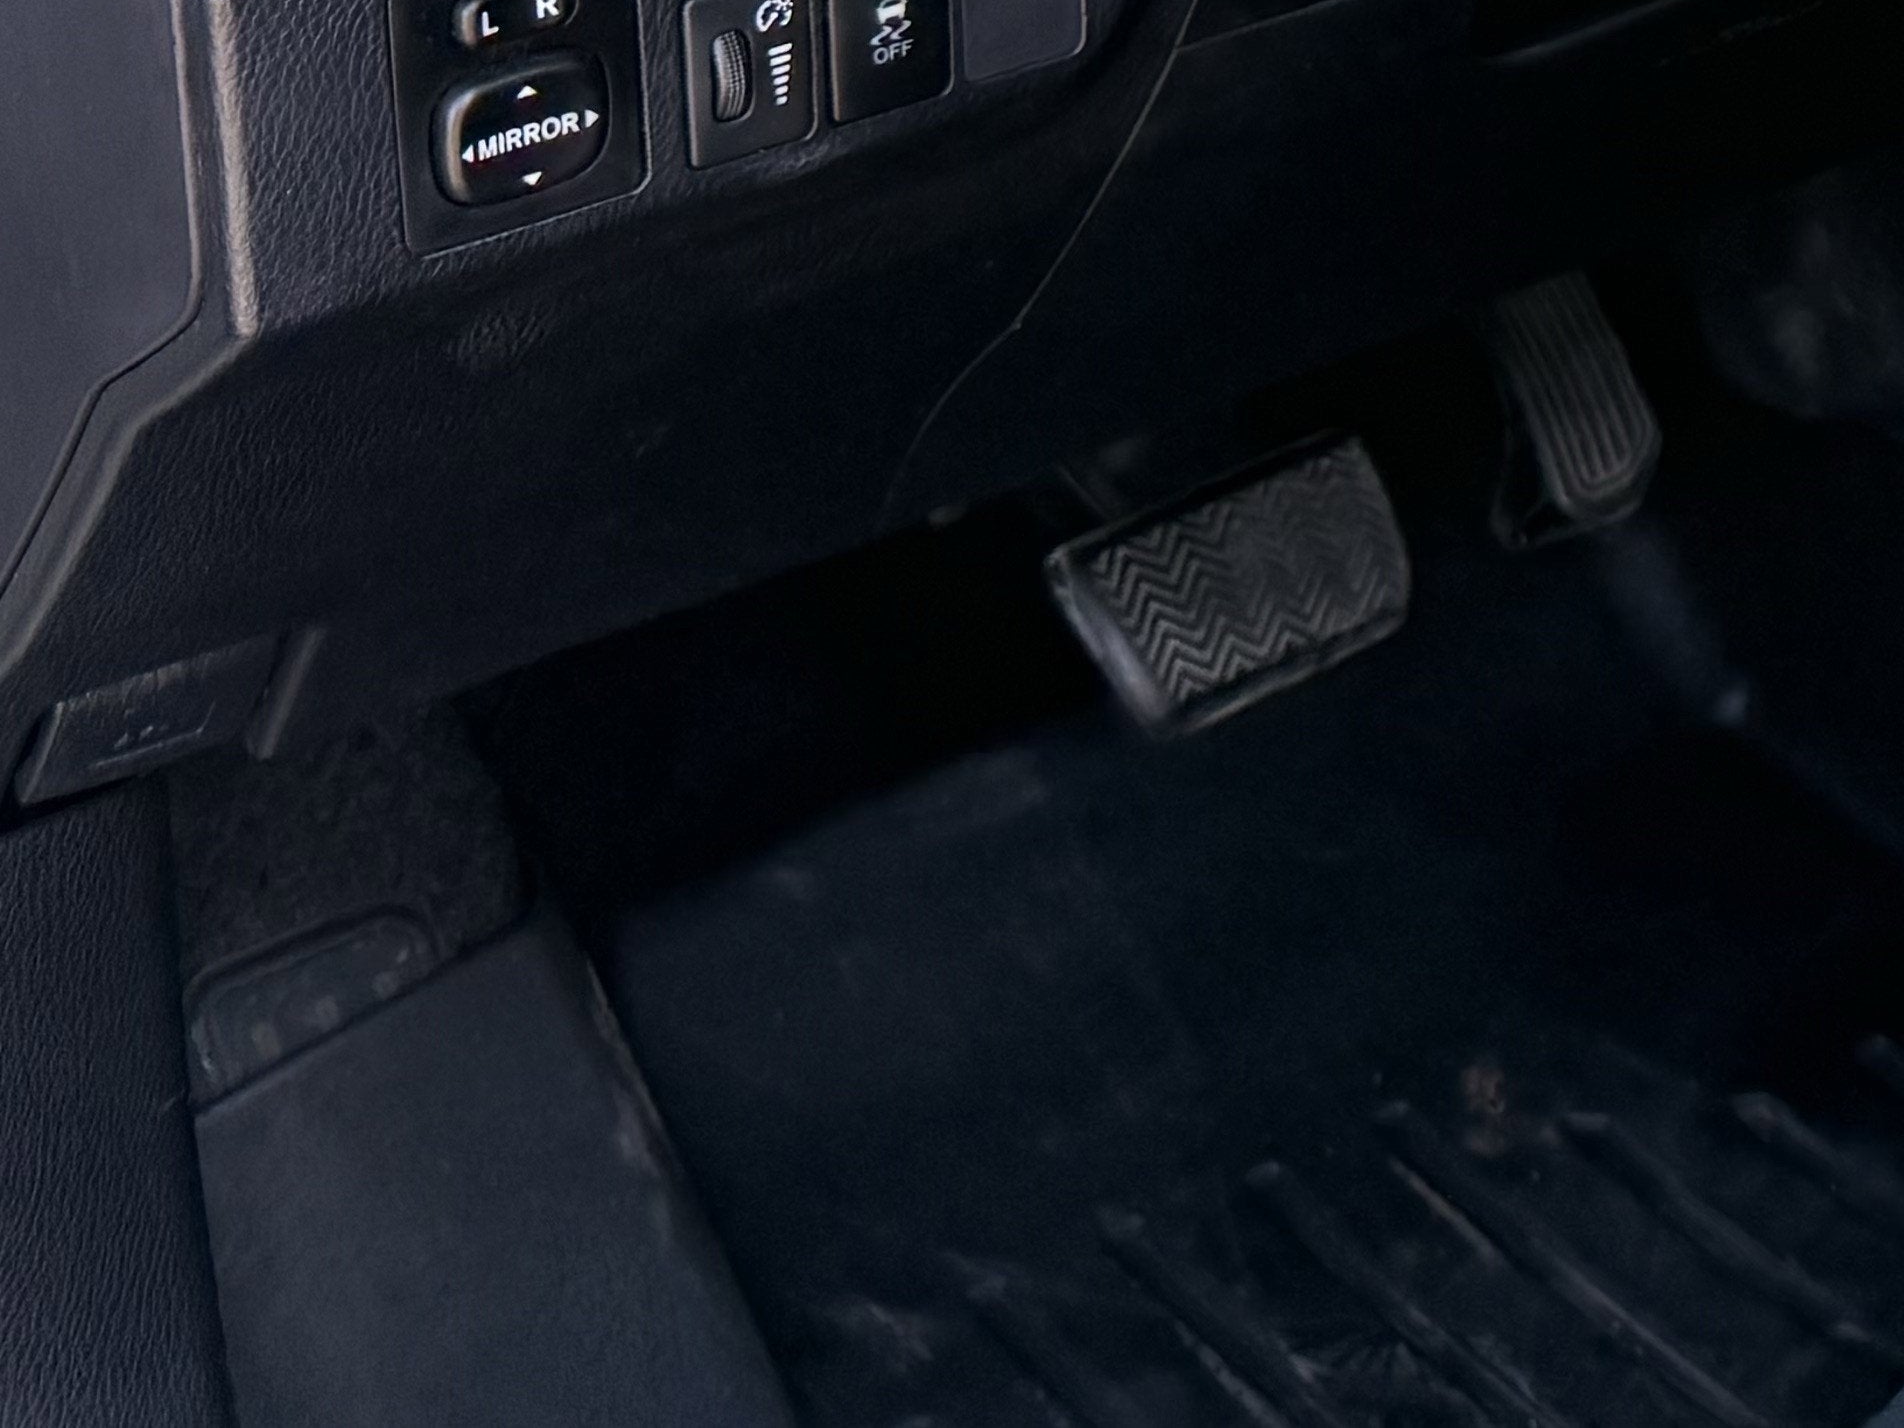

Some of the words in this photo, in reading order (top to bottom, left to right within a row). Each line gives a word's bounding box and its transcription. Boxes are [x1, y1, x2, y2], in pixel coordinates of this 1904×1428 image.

[481, 11, 500, 37] L
[872, 38, 914, 66] OFF
[476, 110, 582, 162] MIRROR
